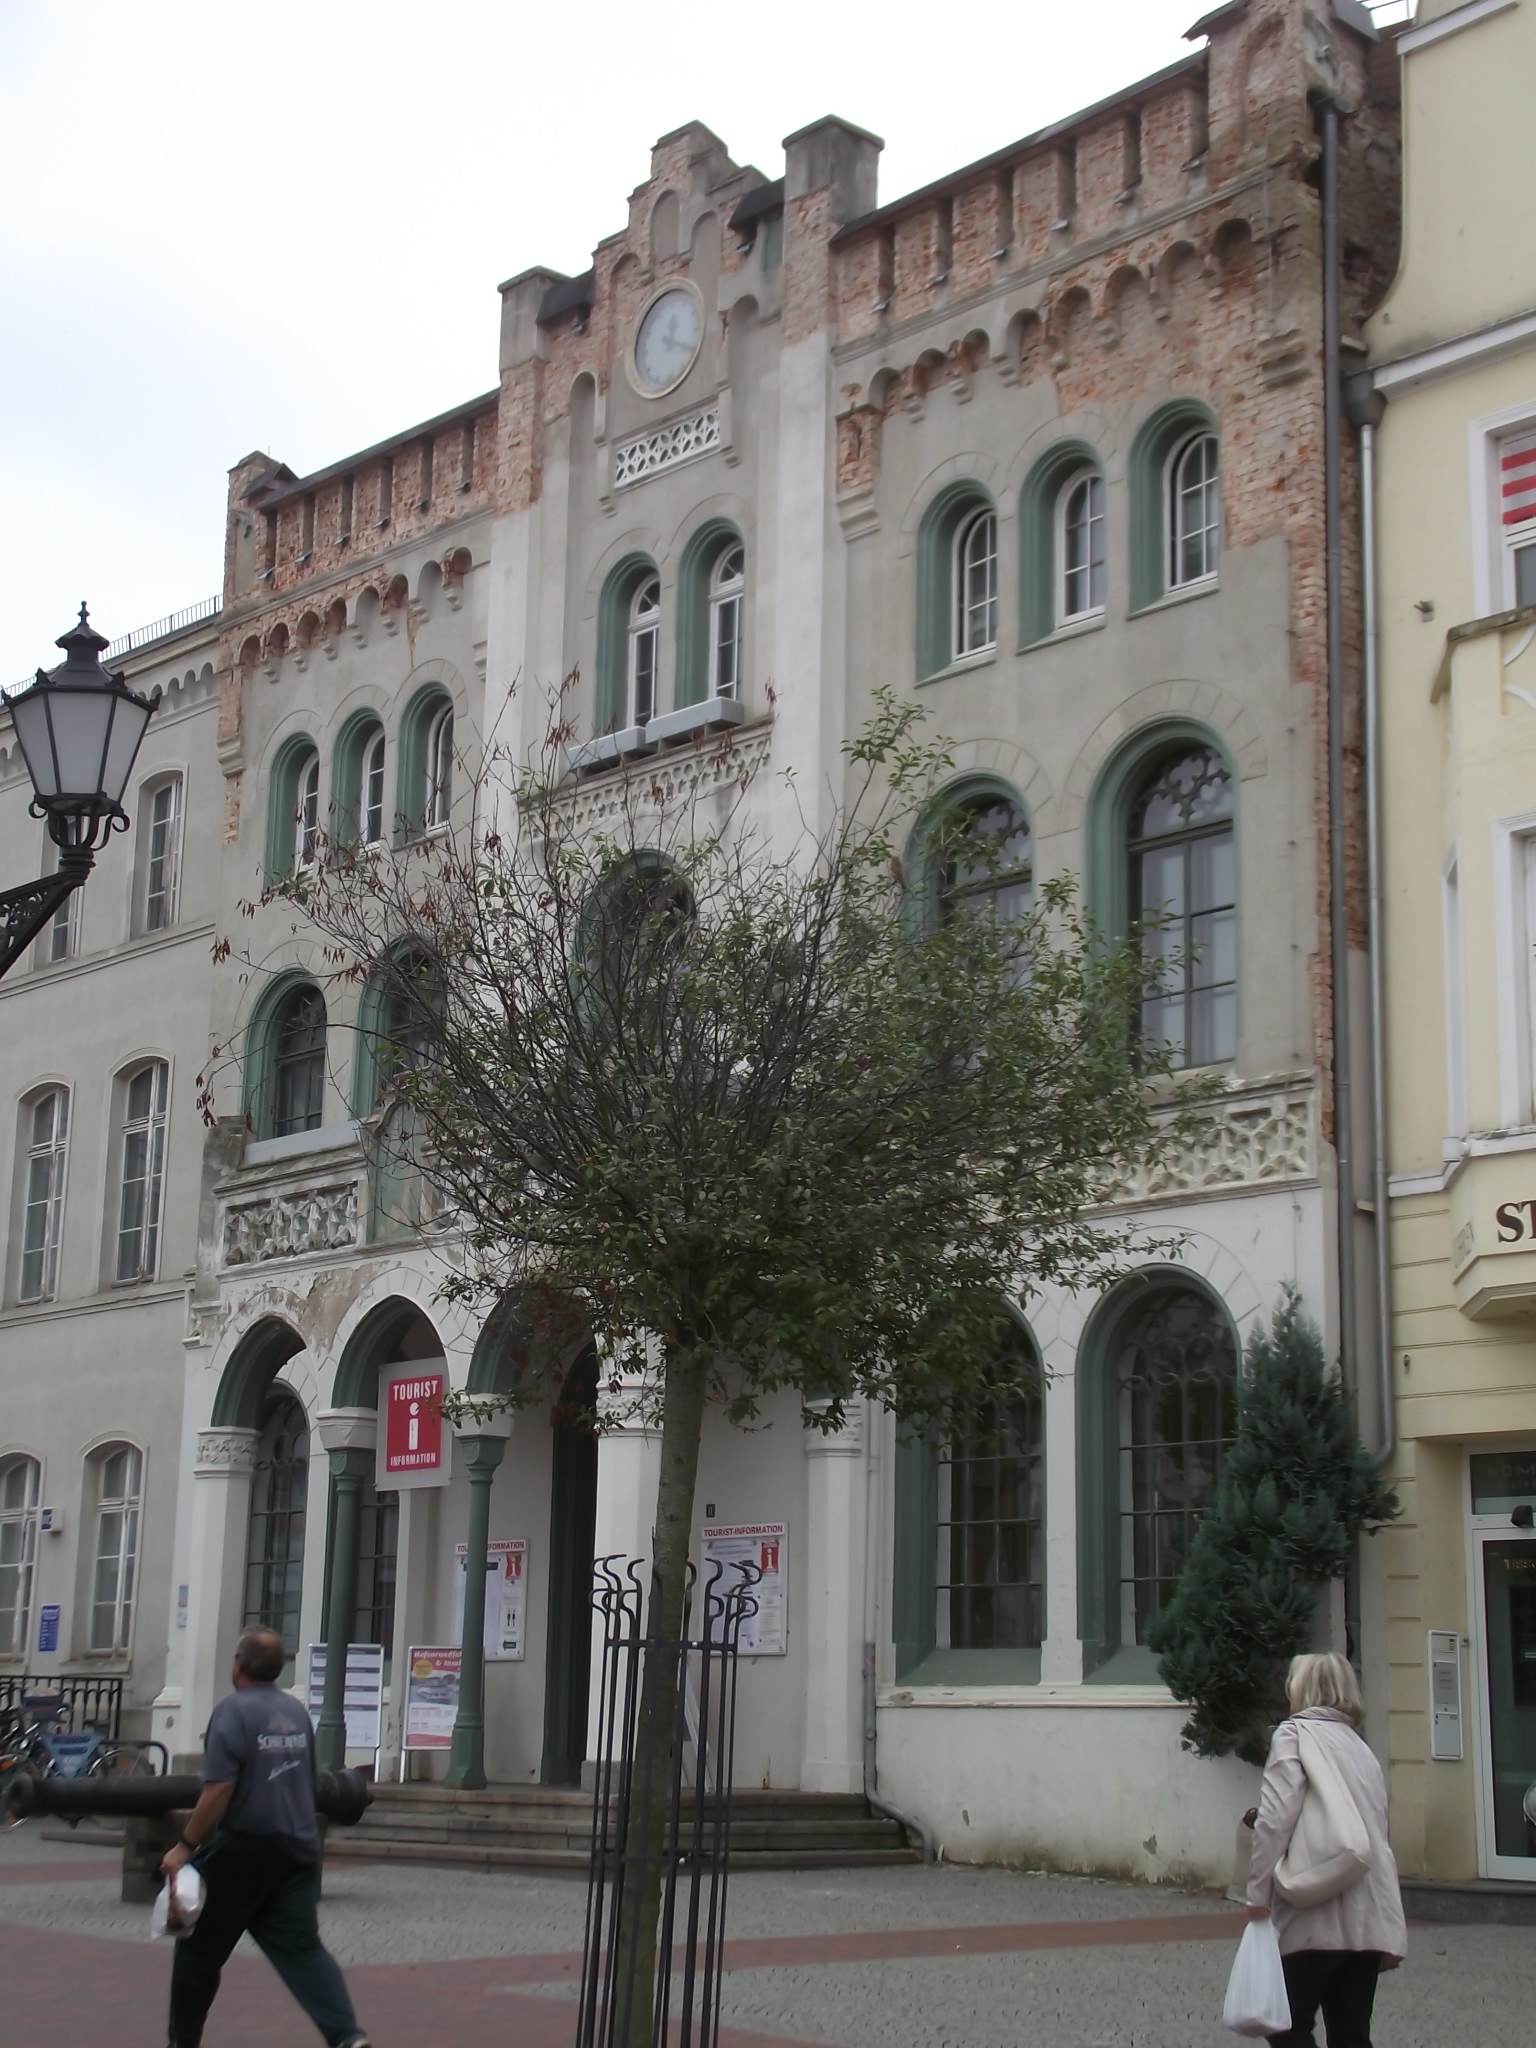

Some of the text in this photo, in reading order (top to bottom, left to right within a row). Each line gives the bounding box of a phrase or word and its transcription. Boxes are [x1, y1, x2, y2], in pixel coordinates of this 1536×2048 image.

[393, 1380, 438, 1401] TOURIST
[390, 1452, 436, 1467] INFORMATION
[703, 1525, 783, 1537] TOURIST-INFORMATION
